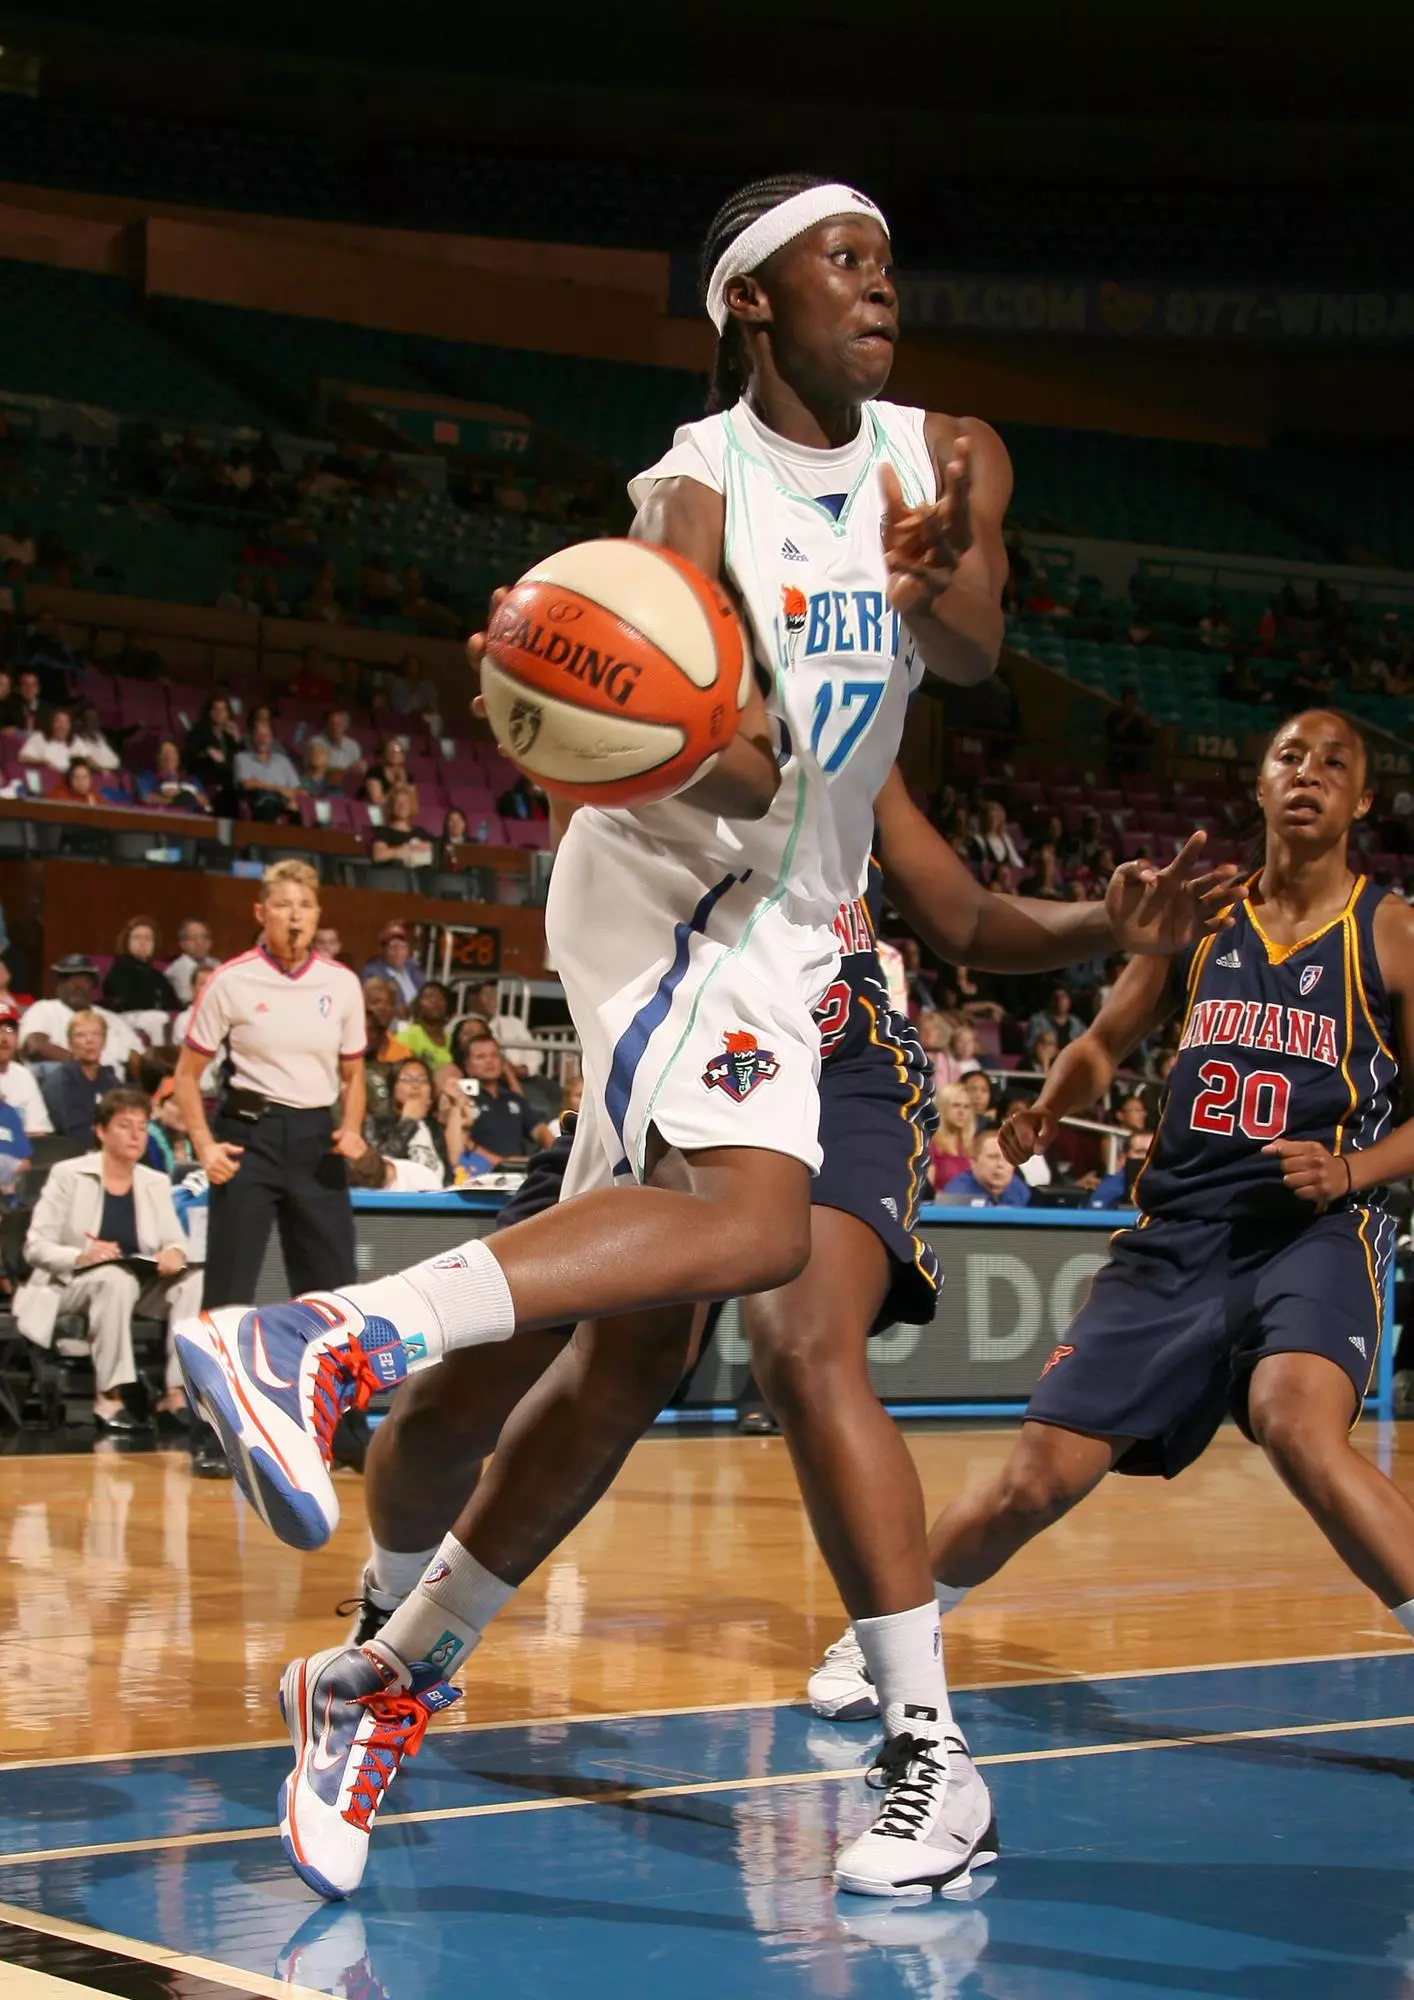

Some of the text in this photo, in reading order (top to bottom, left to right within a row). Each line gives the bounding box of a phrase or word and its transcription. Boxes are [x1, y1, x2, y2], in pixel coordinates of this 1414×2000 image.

[899, 279, 1086, 331] TY.COM
[810, 680, 888, 776] 17
[1179, 999, 1339, 1067] INDIANA
[1189, 1059, 1293, 1140] 20
